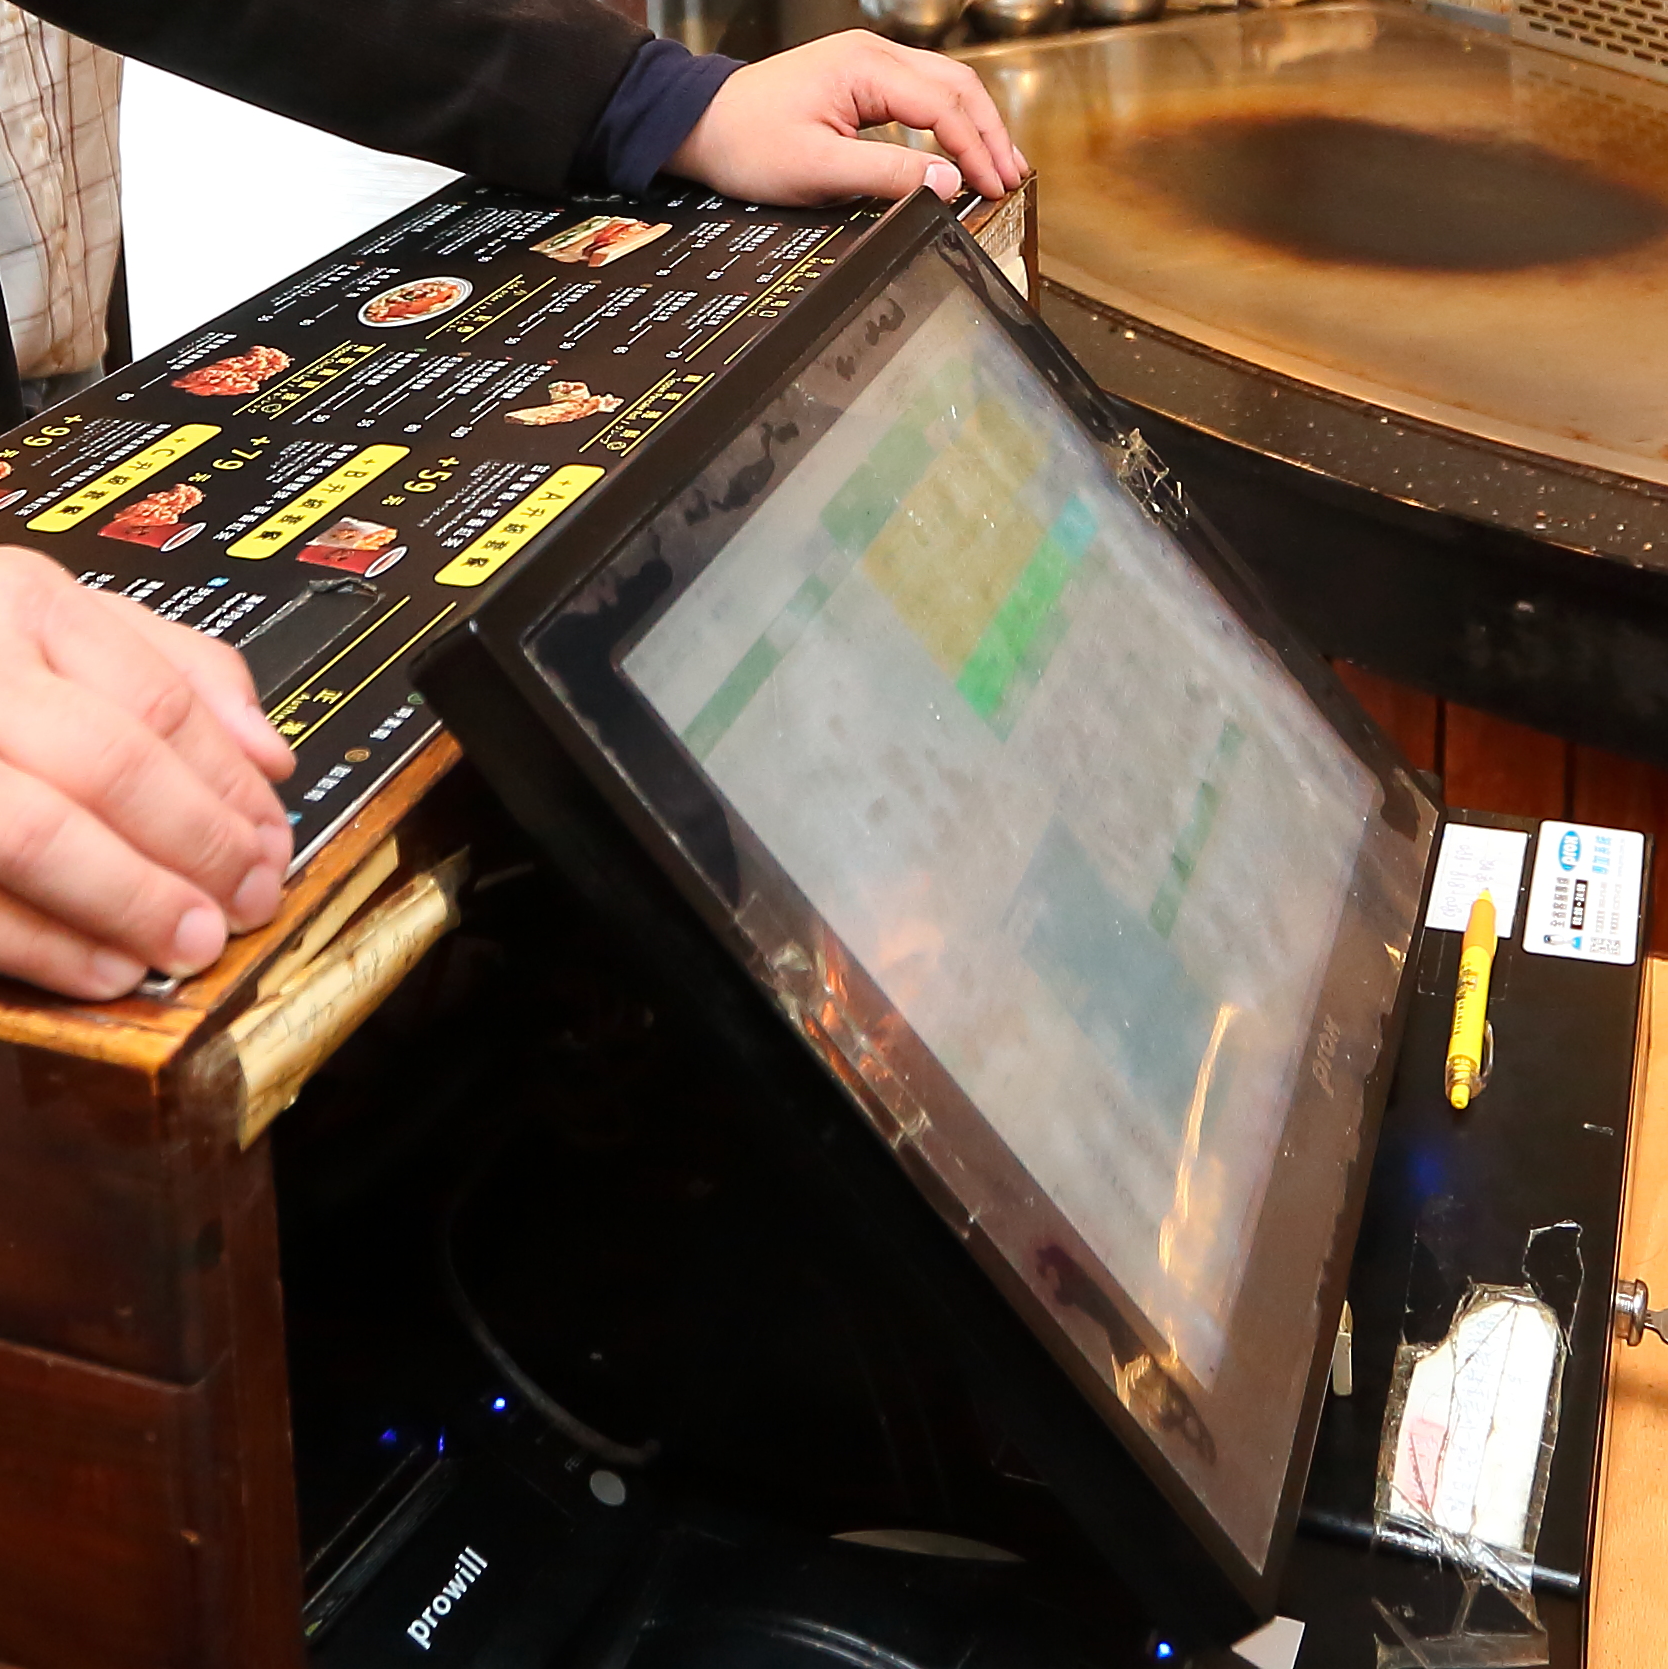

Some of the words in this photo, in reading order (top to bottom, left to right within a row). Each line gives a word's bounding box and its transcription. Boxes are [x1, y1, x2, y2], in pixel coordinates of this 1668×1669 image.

[23, 415, 82, 446] +99
[213, 437, 270, 469] +79
[188, 473, 211, 482] 元
[404, 457, 459, 492] +59
[382, 495, 405, 505] 元
[406, 1545, 489, 1651] prowill
